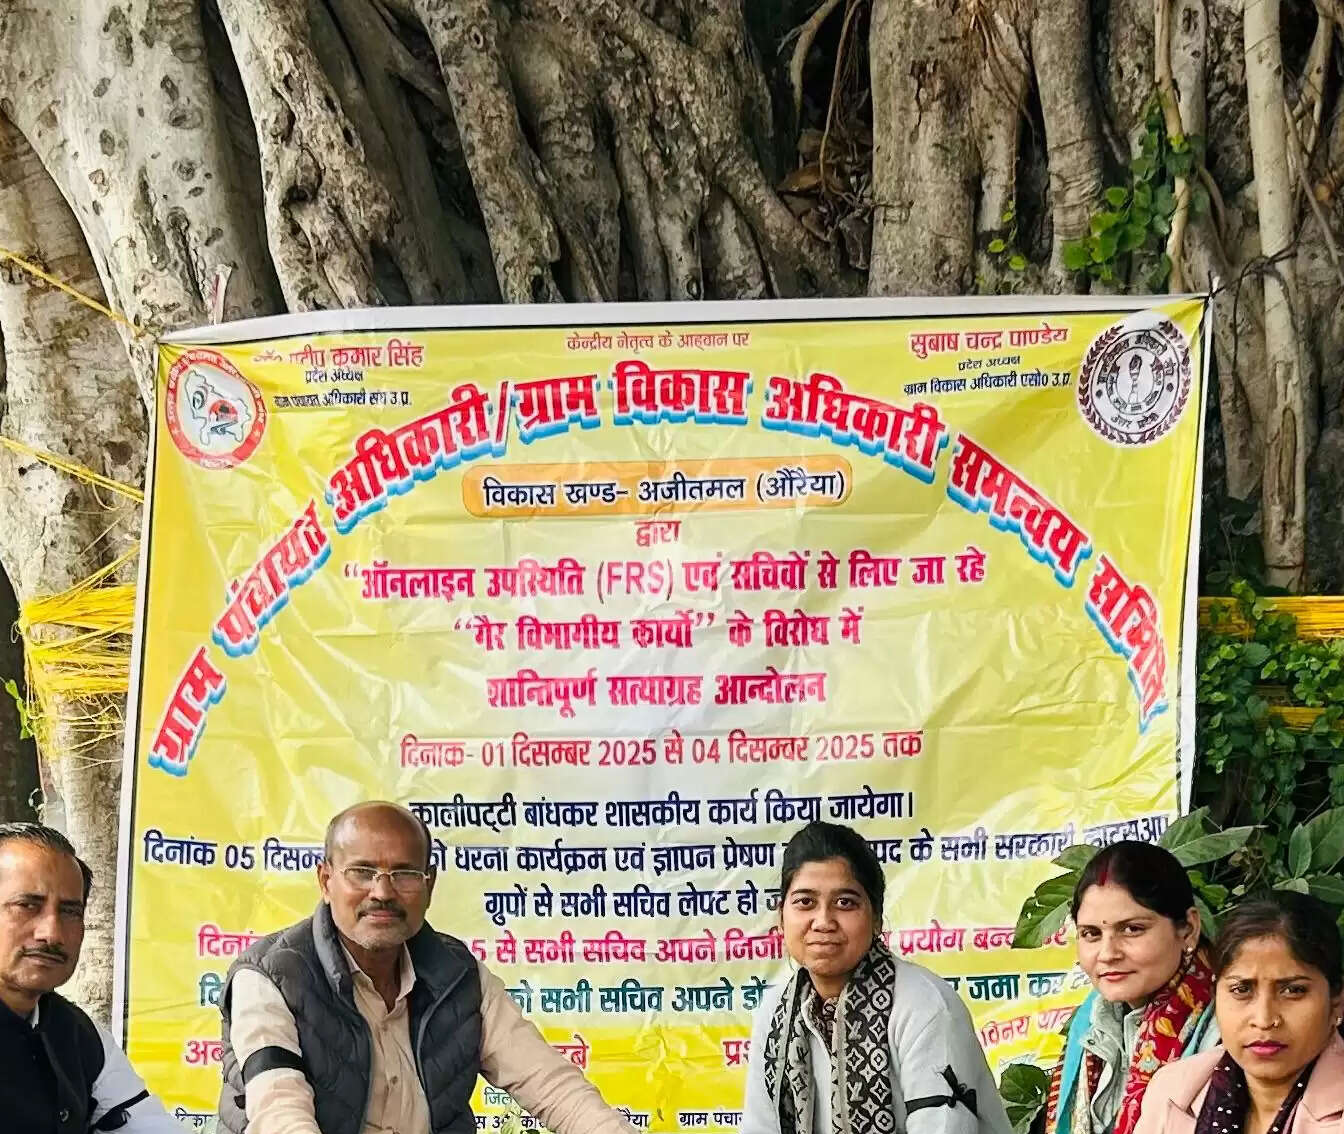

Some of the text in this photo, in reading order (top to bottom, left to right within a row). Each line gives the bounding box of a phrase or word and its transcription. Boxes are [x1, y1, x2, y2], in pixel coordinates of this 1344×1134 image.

[388, 338, 424, 367] सिंह
[567, 331, 613, 351] केन्द्रीय
[617, 332, 653, 354] नेतृत्व
[659, 331, 673, 349] के
[733, 332, 750, 347] पर
[965, 332, 1002, 350] चन्द्र
[1008, 323, 1068, 346] पाण्डेय
[930, 378, 966, 394] विकास
[970, 371, 1017, 390] अधिकारी
[483, 477, 556, 507] विकास
[638, 471, 745, 502] अजीतमल
[635, 520, 681, 547] द्वारा
[149, 645, 226, 770] ग्राम
[213, 498, 331, 653] पंचायत
[612, 361, 750, 421] विकास
[763, 373, 946, 475] अधिकारी
[949, 433, 1088, 578] समन्वय
[485, 558, 585, 599] उपस्थिति
[597, 560, 672, 603] (FRS)
[682, 554, 722, 592] एवं
[730, 551, 809, 591] सचिवों
[817, 551, 840, 588] से
[849, 550, 902, 588] लिए
[910, 556, 946, 585] जा
[955, 546, 985, 583] रहे
[516, 614, 621, 650] विभागीय
[727, 609, 753, 647] के
[764, 608, 830, 647] विरोध
[839, 607, 864, 645] में
[487, 666, 827, 718] शान्तिपूर्ण सत्याग्रह आन्दोलन
[482, 742, 504, 767] 01
[512, 732, 592, 767] दिसम्बर
[598, 739, 656, 766] 2025
[664, 729, 684, 764] से
[692, 739, 721, 765] 04
[815, 734, 874, 761] 2025
[882, 730, 924, 759] तक
[409, 793, 517, 833] कालीपट्टी
[523, 796, 599, 828] बांधकर
[605, 790, 700, 827] शासकीय
[707, 788, 759, 826] कार्य
[765, 788, 822, 823] किया
[144, 829, 218, 867] दिनांक
[225, 845, 255, 870] 05
[455, 846, 509, 873] धरना
[517, 838, 606, 875] कार्यक्रम
[614, 843, 645, 872] एवं
[651, 844, 715, 877] ज्ञापन
[723, 837, 775, 871] प्रेषण
[910, 828, 935, 862] के
[940, 827, 986, 861] सभी
[995, 823, 1074, 860] सरकारी
[534, 883, 554, 918] से
[560, 883, 606, 918] सभी
[613, 883, 671, 918] सचिव
[678, 881, 731, 916] लेफ्ट
[737, 880, 758, 915] हो
[198, 924, 264, 957] दिनां
[496, 930, 517, 964] से
[524, 930, 574, 964] सभी
[582, 930, 647, 963] सचिव
[655, 929, 717, 963] अपने
[724, 928, 784, 963] निजी
[899, 919, 966, 955] प्रयोग
[539, 979, 592, 1013] सभी
[599, 979, 664, 1013] सचिव
[671, 977, 737, 1012] अपने
[966, 974, 1021, 1001] जमा
[1027, 972, 1068, 999] कर
[679, 1112, 708, 1128] ग्राम
